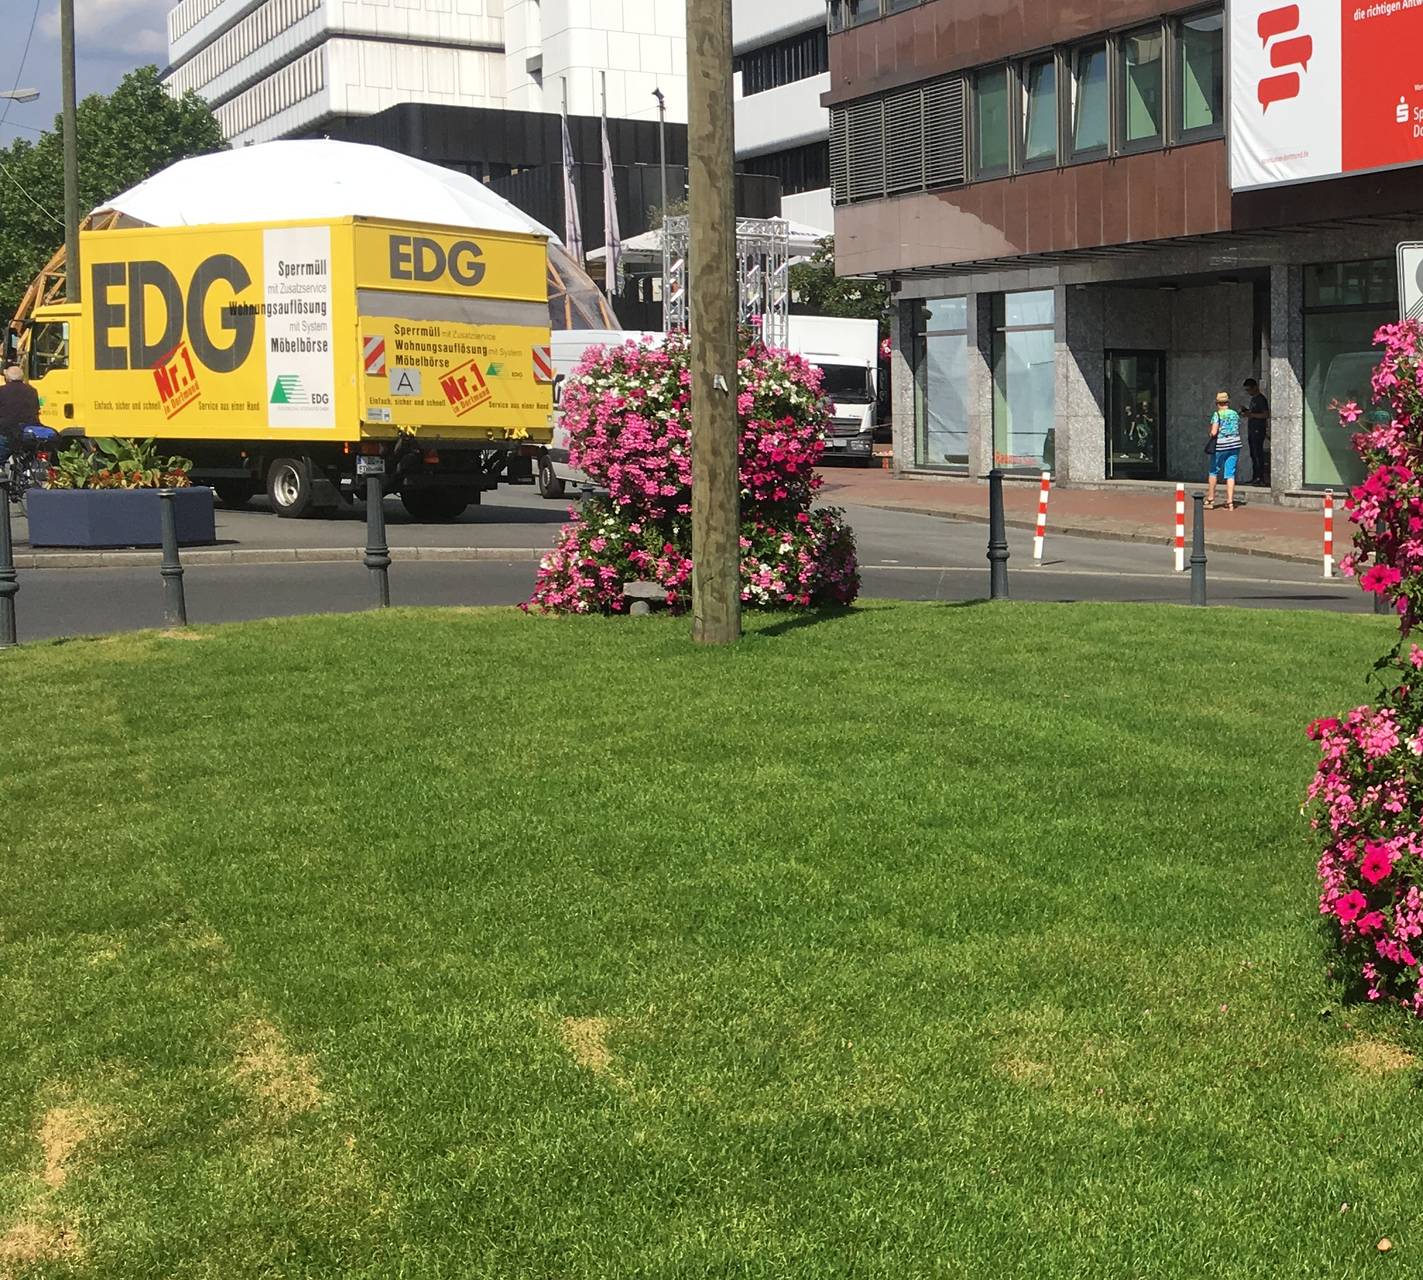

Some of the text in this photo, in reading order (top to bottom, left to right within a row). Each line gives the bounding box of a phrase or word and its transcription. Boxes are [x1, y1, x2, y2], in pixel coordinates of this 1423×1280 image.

[1353, 8, 1365, 21] die
[1366, 1, 1401, 17] richtigen
[278, 259, 327, 278] Sperrmüll
[389, 235, 486, 287] EDG
[280, 282, 327, 294] Zusatzservice
[91, 253, 256, 374] EDG
[229, 299, 327, 317] Wohnungsauflösung
[301, 320, 328, 334] System
[393, 323, 441, 338] Sperrmüll
[270, 337, 328, 353] Möbelbörse
[394, 339, 488, 357] Wohnungsauflösung
[394, 354, 450, 368] Möbelbörse
[397, 371, 414, 392] A
[440, 362, 486, 405] Nr.1
[311, 393, 329, 404] EDG
